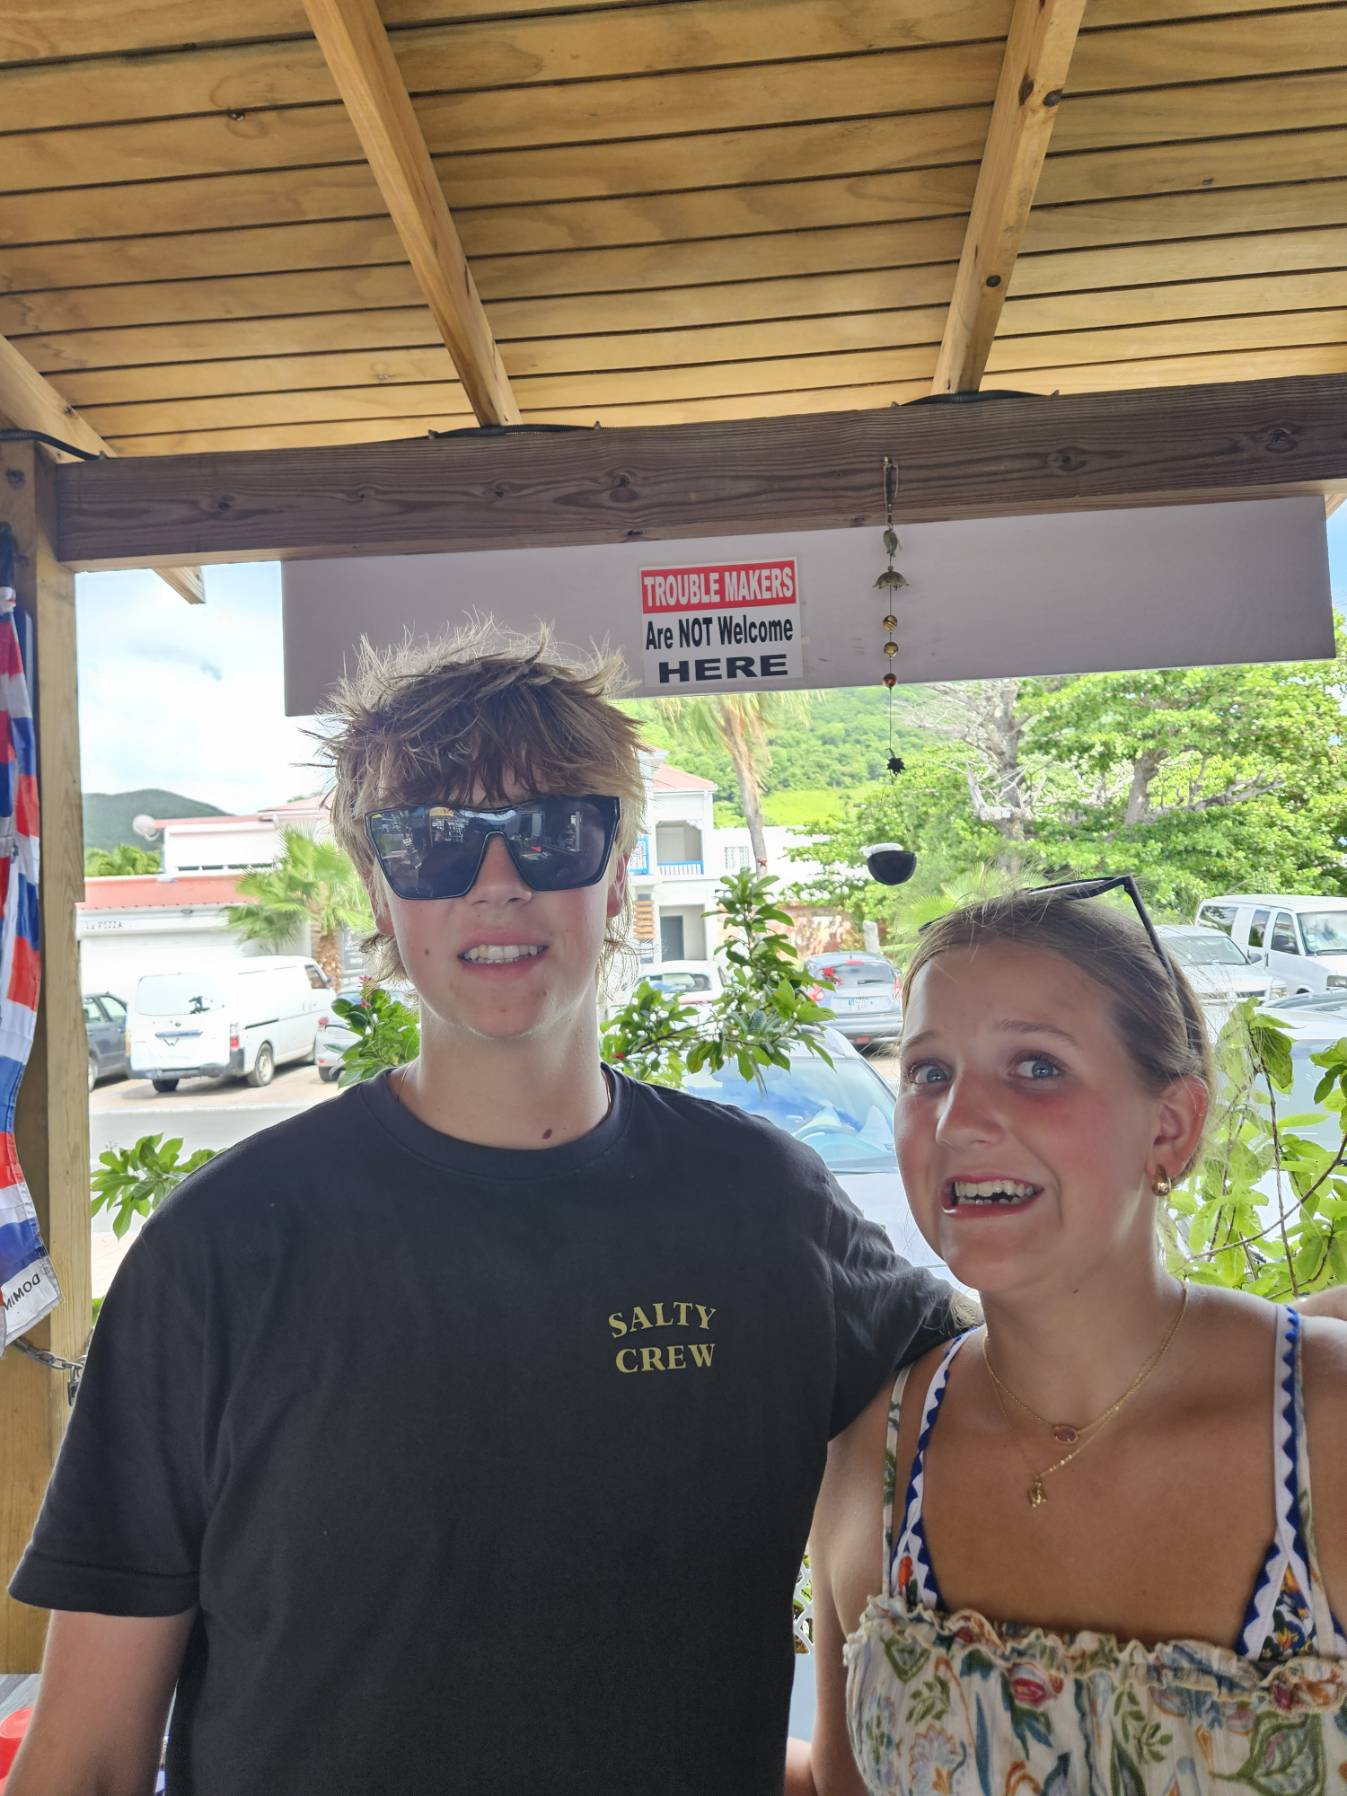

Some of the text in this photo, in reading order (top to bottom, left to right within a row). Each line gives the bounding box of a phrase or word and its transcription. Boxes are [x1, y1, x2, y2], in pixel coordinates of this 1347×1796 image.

[644, 566, 794, 607] TROUBLE MAKERS
[645, 614, 793, 651] Are NOT Welcome
[658, 654, 788, 684] HERE
[608, 1301, 717, 1339] SALTY
[615, 1343, 715, 1374] CREW
